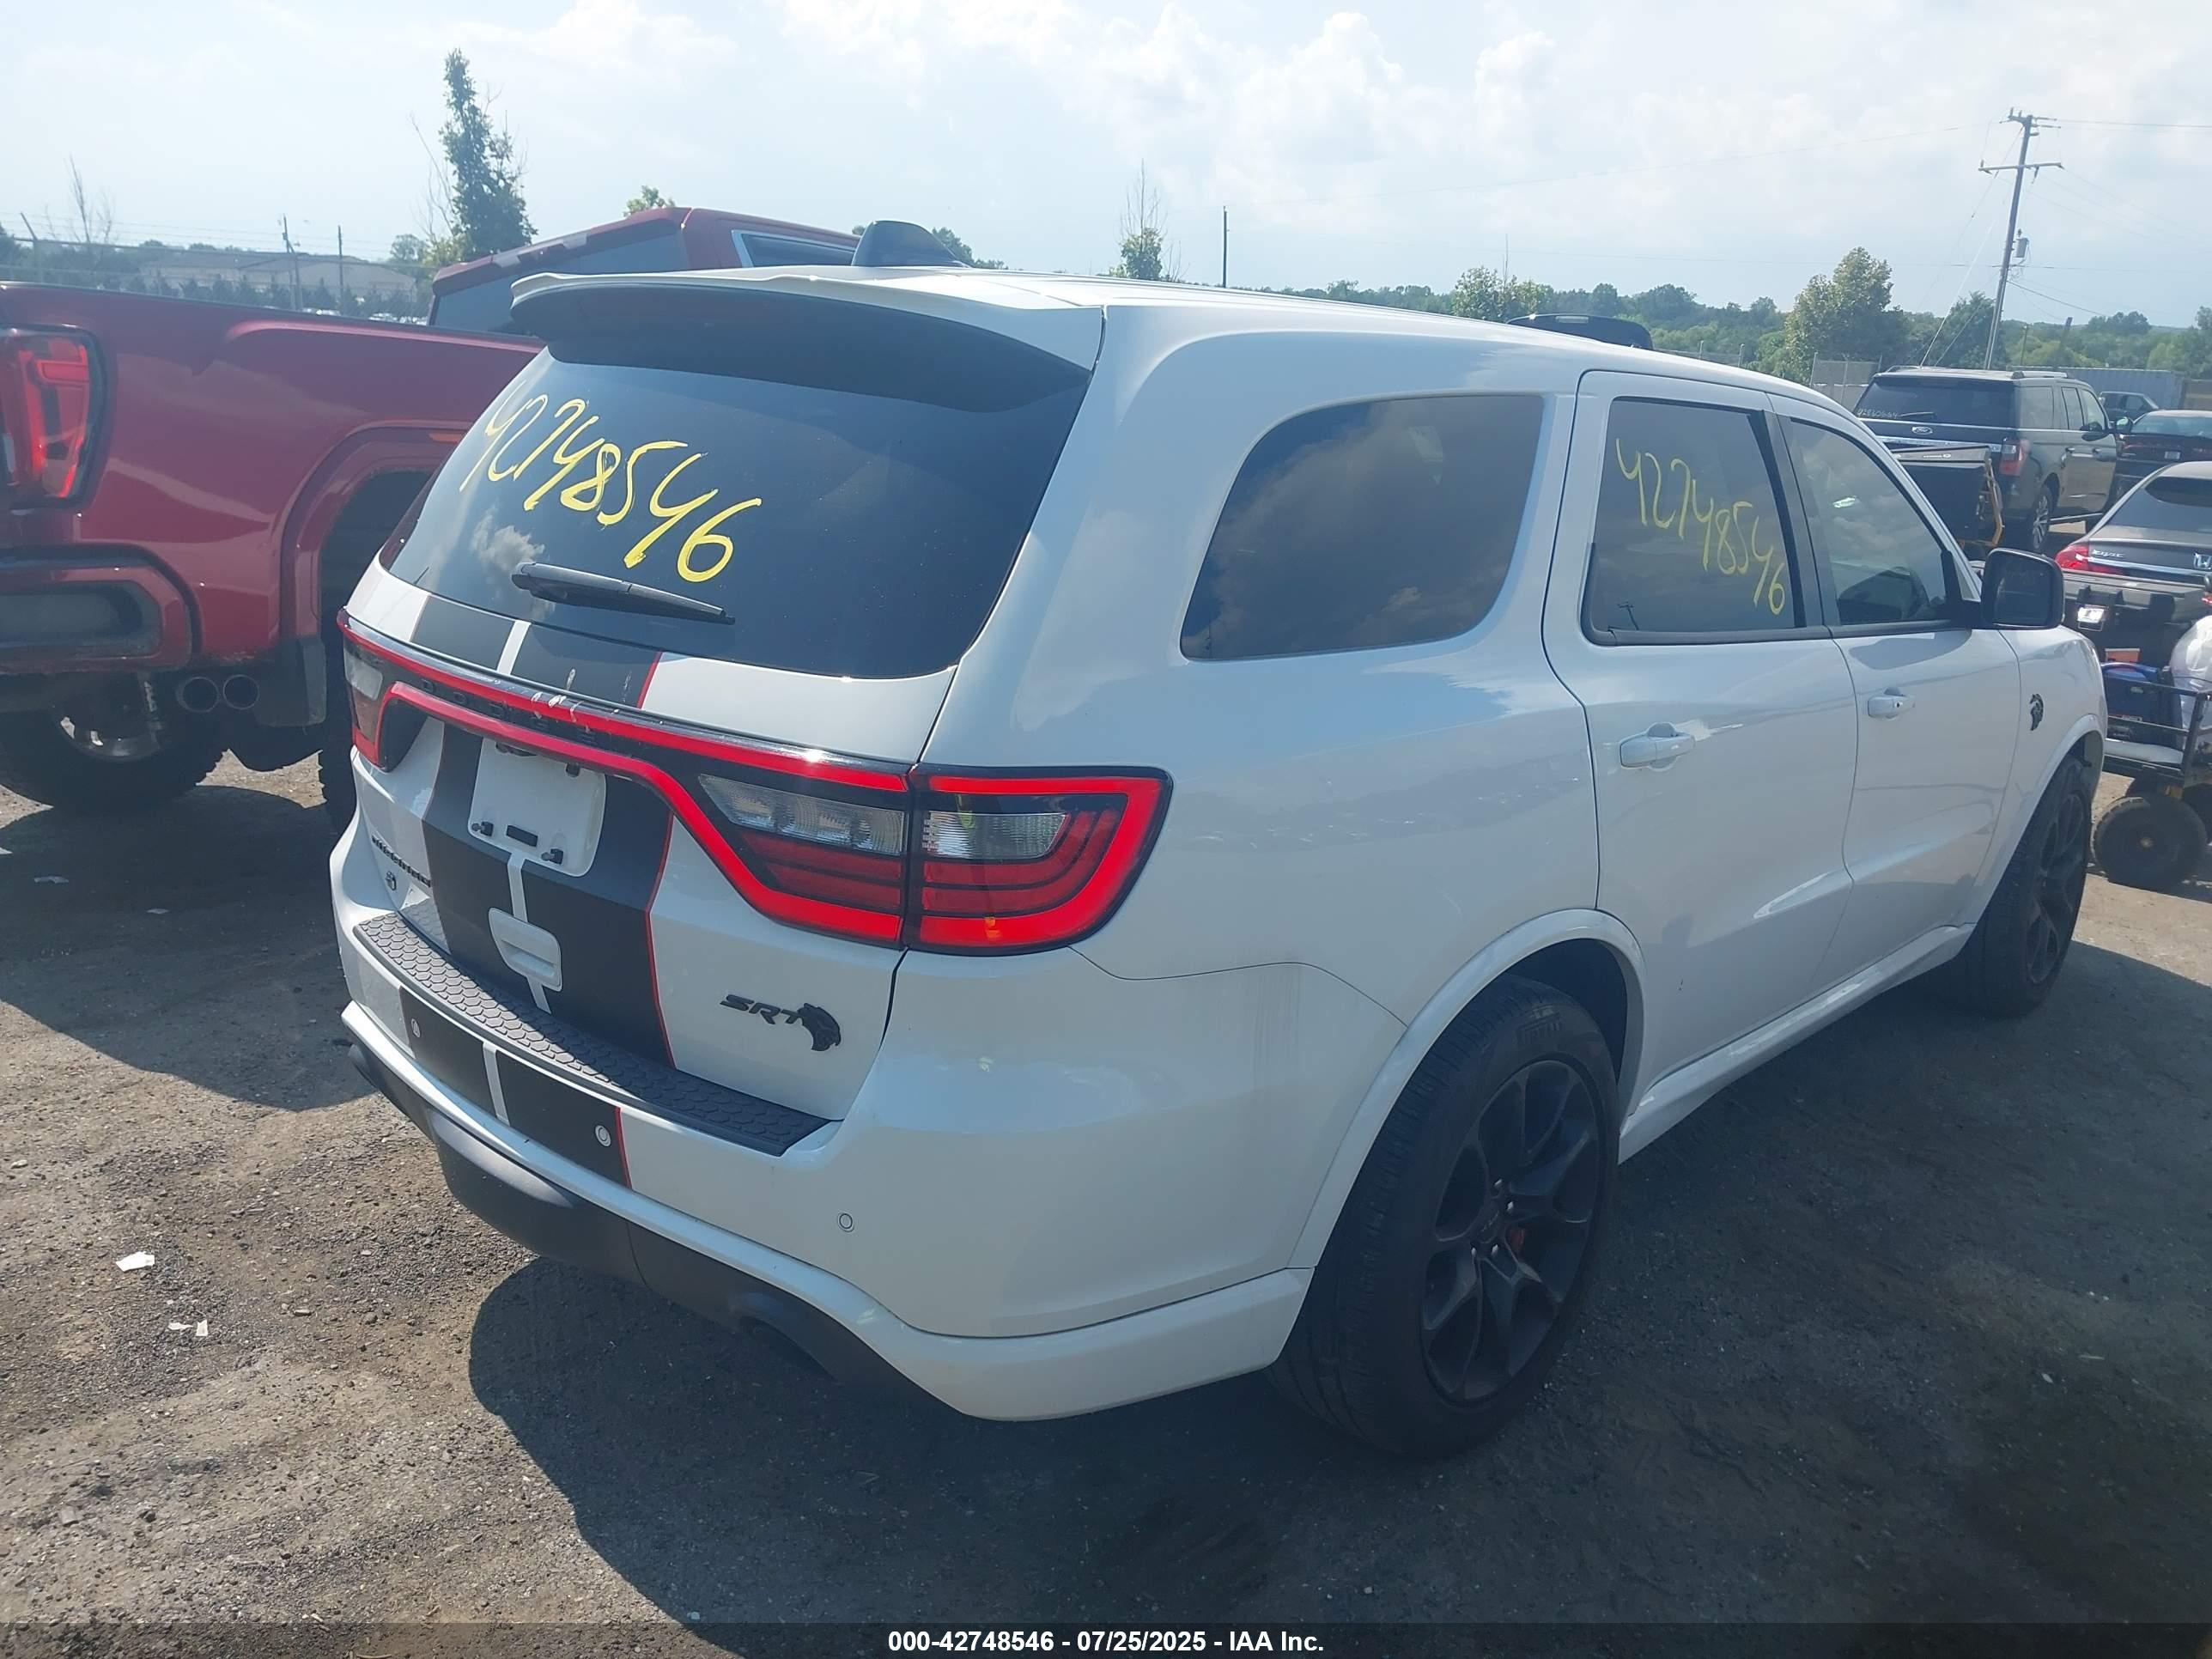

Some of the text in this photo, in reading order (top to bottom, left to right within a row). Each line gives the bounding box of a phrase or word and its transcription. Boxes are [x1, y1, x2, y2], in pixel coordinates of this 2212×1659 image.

[459, 380, 762, 583] 42748546
[1615, 438, 1785, 616] 42748546
[719, 994, 803, 1025] SRT
